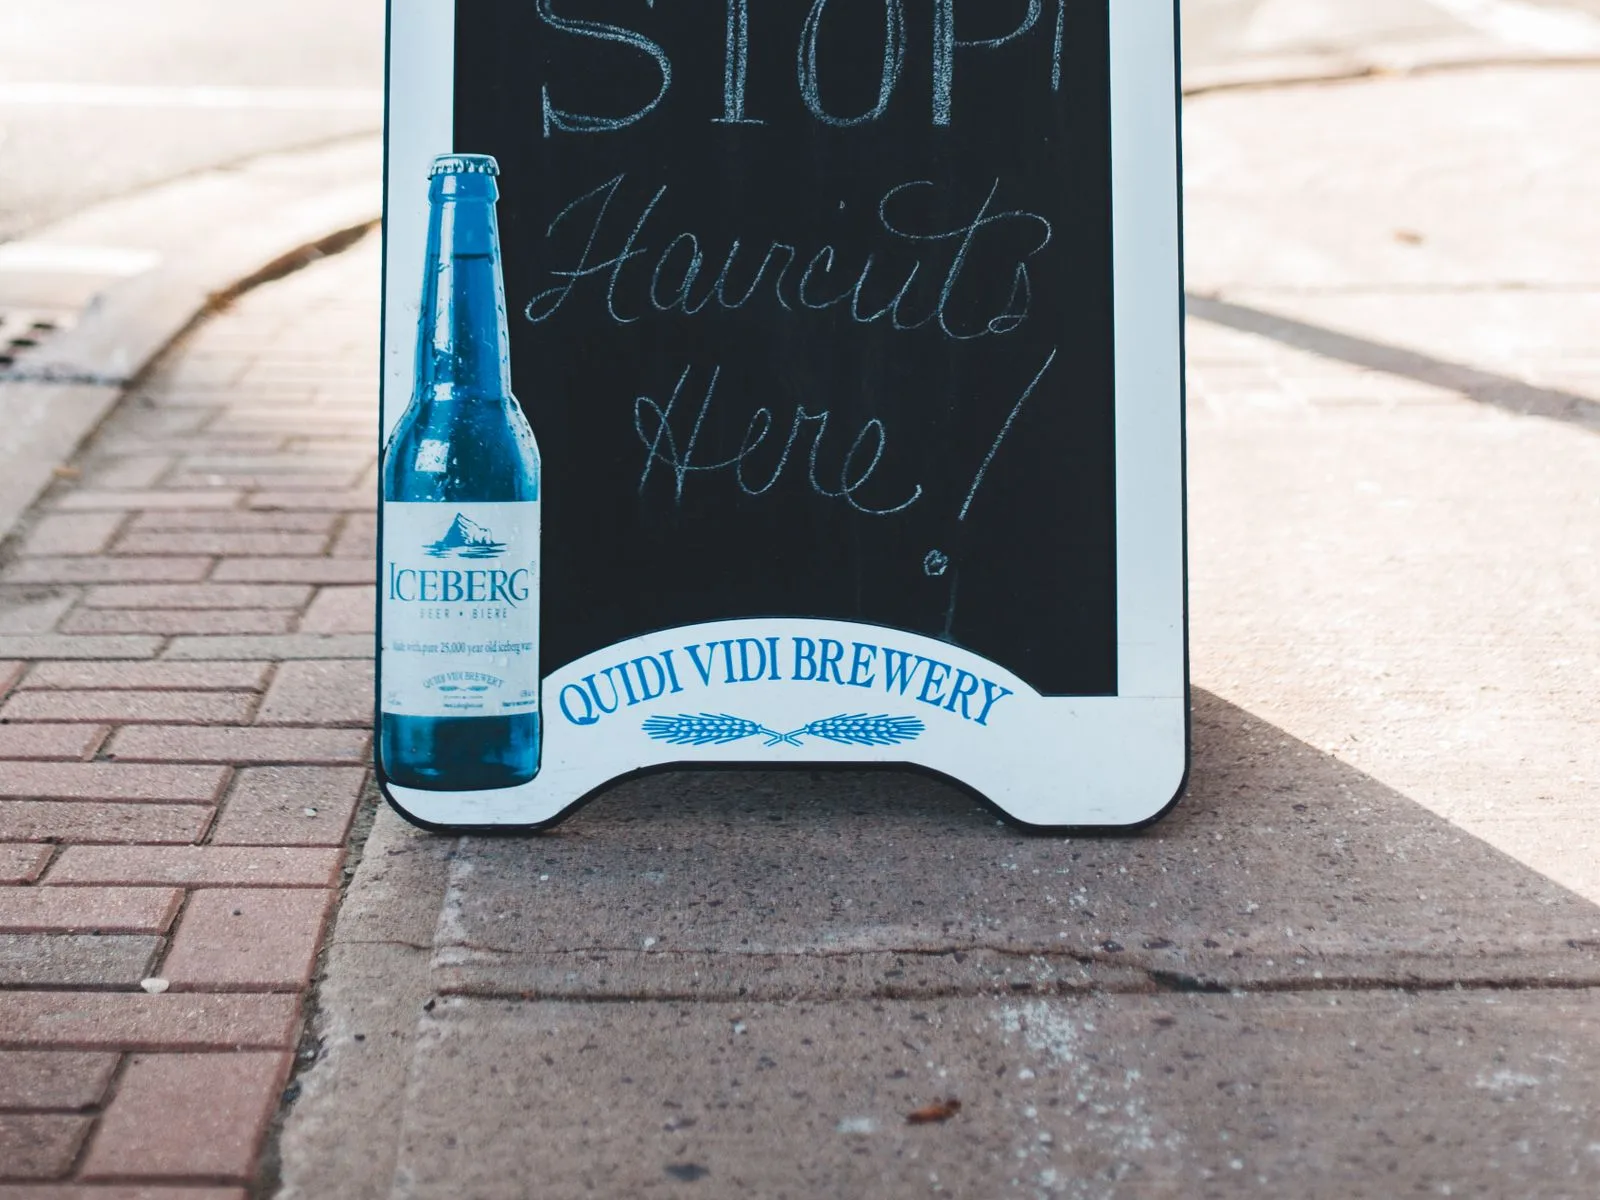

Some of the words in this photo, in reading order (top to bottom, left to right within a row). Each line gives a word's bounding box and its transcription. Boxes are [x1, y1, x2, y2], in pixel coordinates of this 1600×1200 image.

[525, 174, 1053, 340] Haircuts
[634, 348, 1057, 576] Here!
[389, 562, 529, 609] ICEBERG
[472, 607, 508, 619] BIERE
[559, 649, 684, 726] QUIDI
[684, 636, 783, 687] VIDI
[791, 636, 1014, 728] BREWERY
